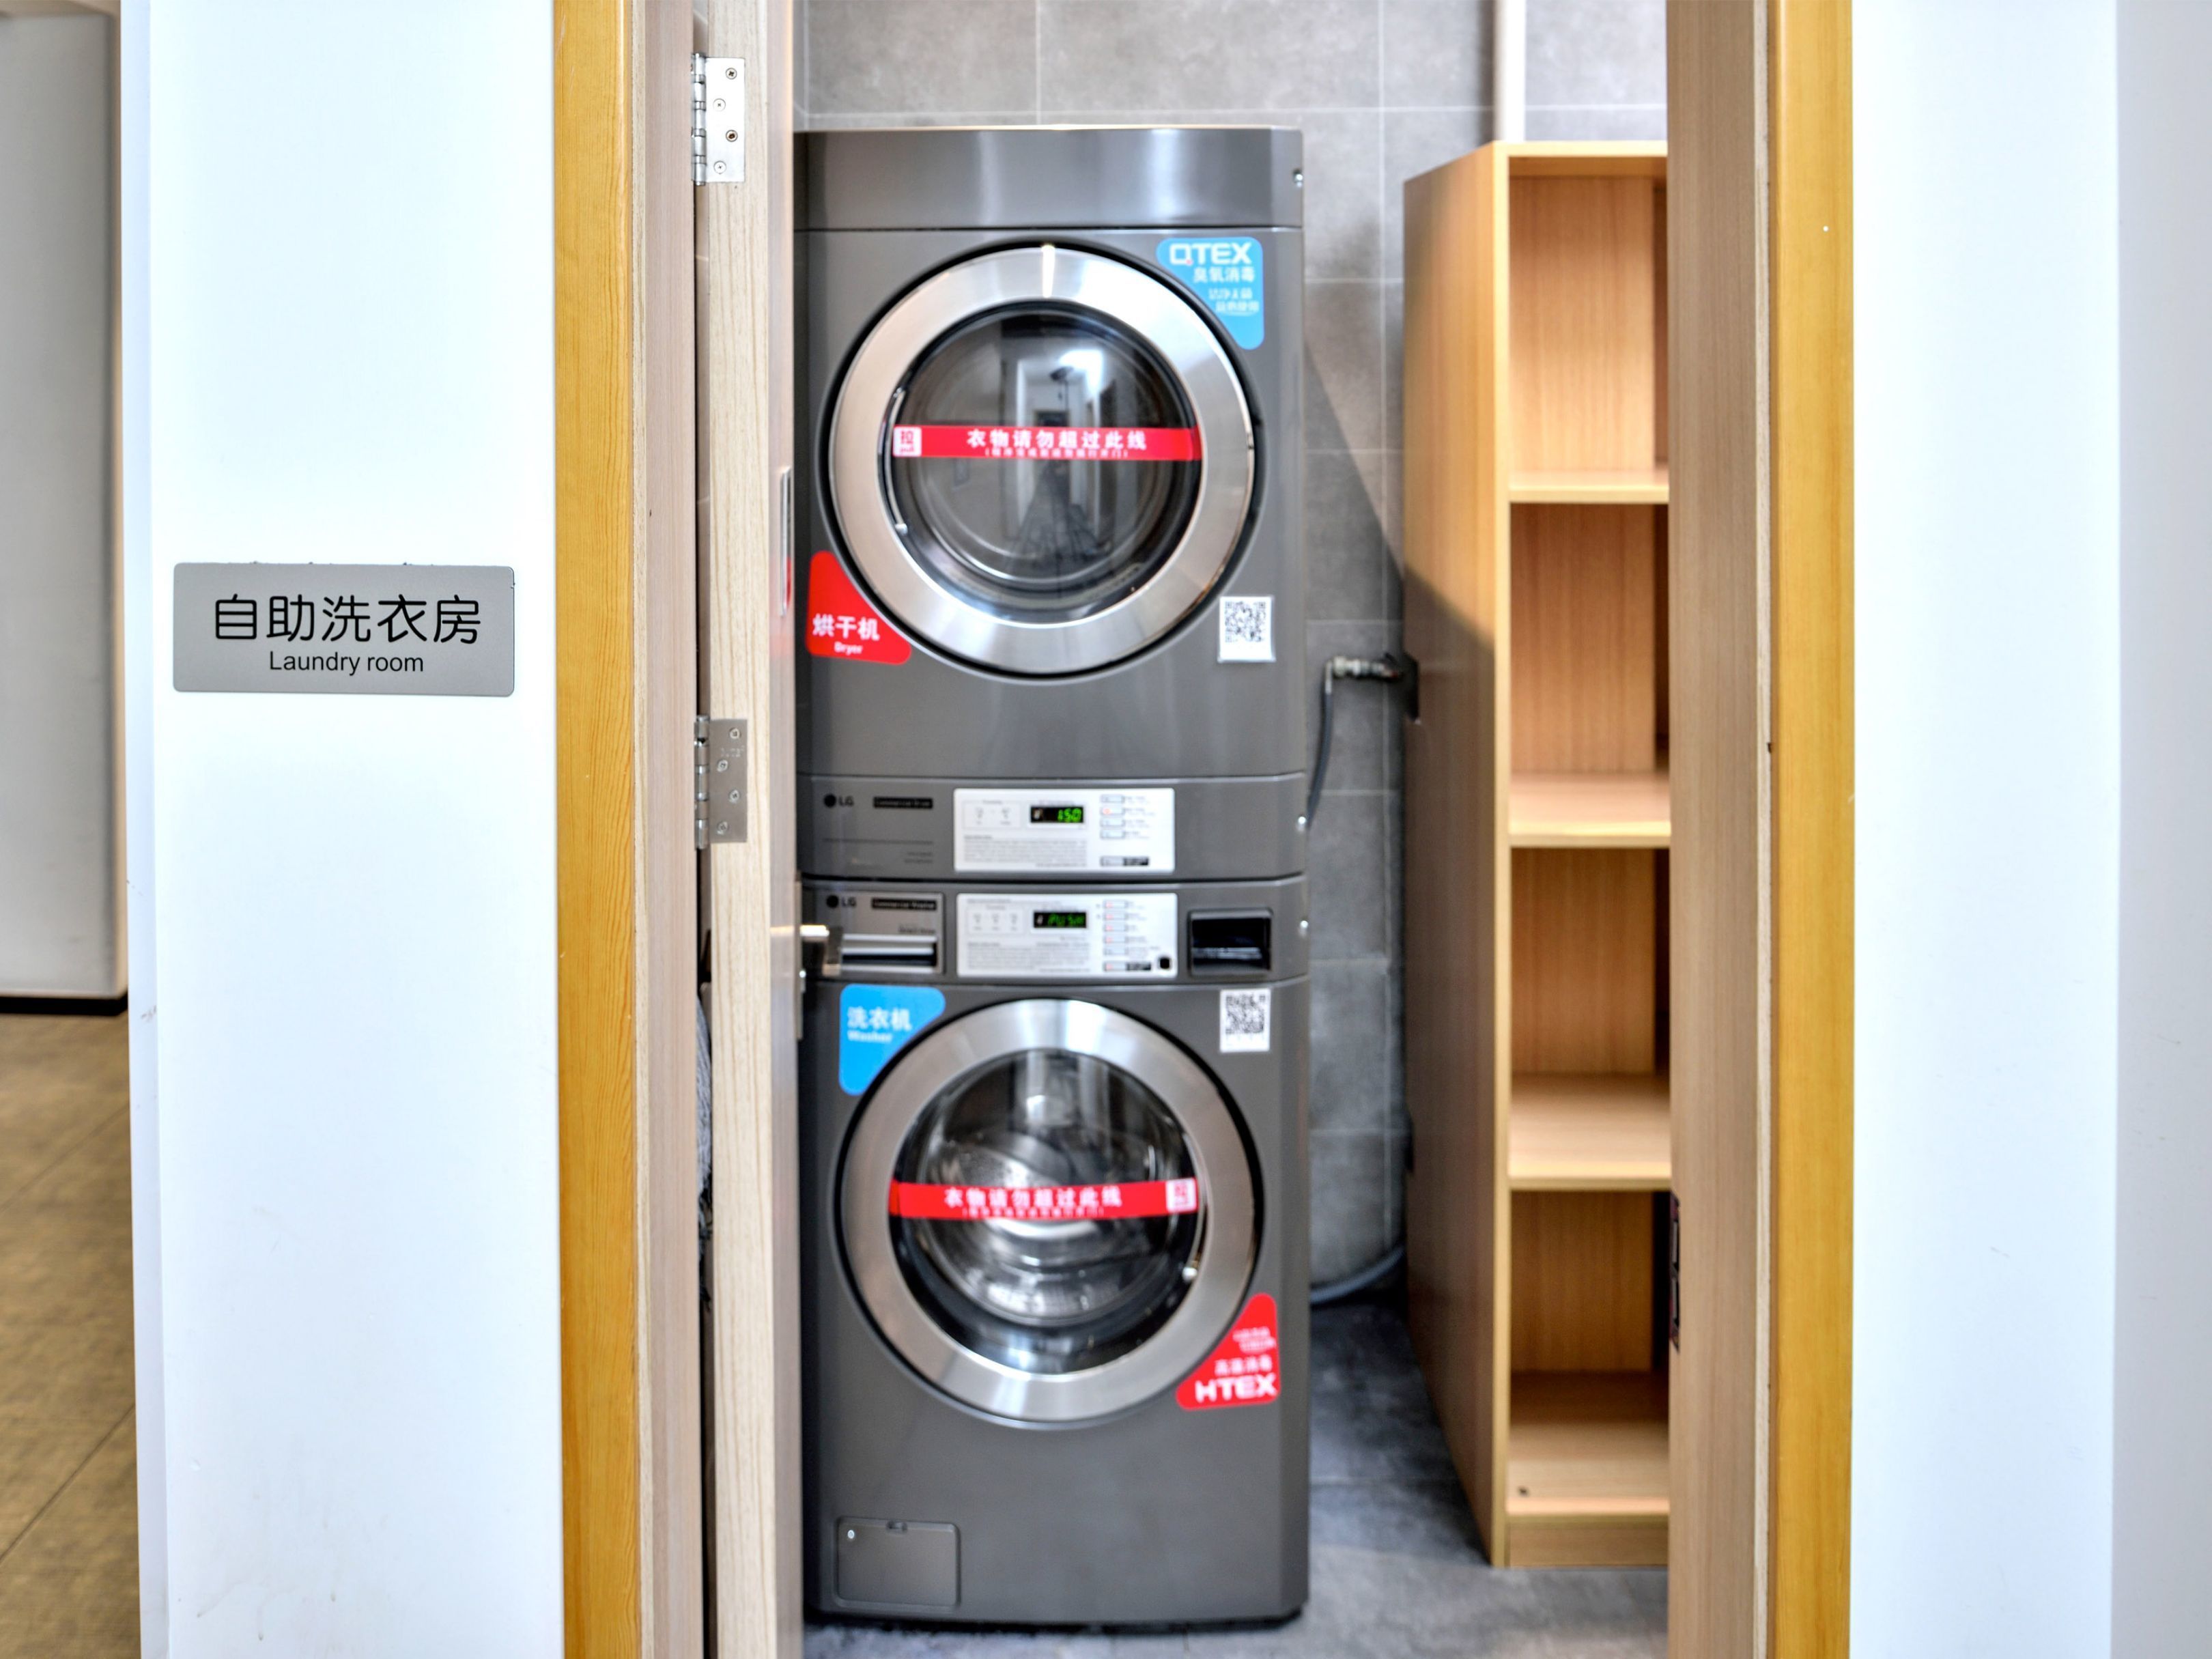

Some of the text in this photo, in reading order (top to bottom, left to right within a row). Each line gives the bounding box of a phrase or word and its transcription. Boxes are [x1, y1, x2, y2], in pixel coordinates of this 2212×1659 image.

[967, 429, 1147, 450] 衣物请勿超过此线
[215, 593, 481, 644] 自助洗衣房
[812, 613, 880, 641] 烘干机
[270, 651, 424, 676] Laundry room
[838, 795, 854, 807] LG
[841, 896, 857, 907] LG
[847, 1006, 912, 1031] 洗衣机
[1195, 1372, 1277, 1403] HTEX
